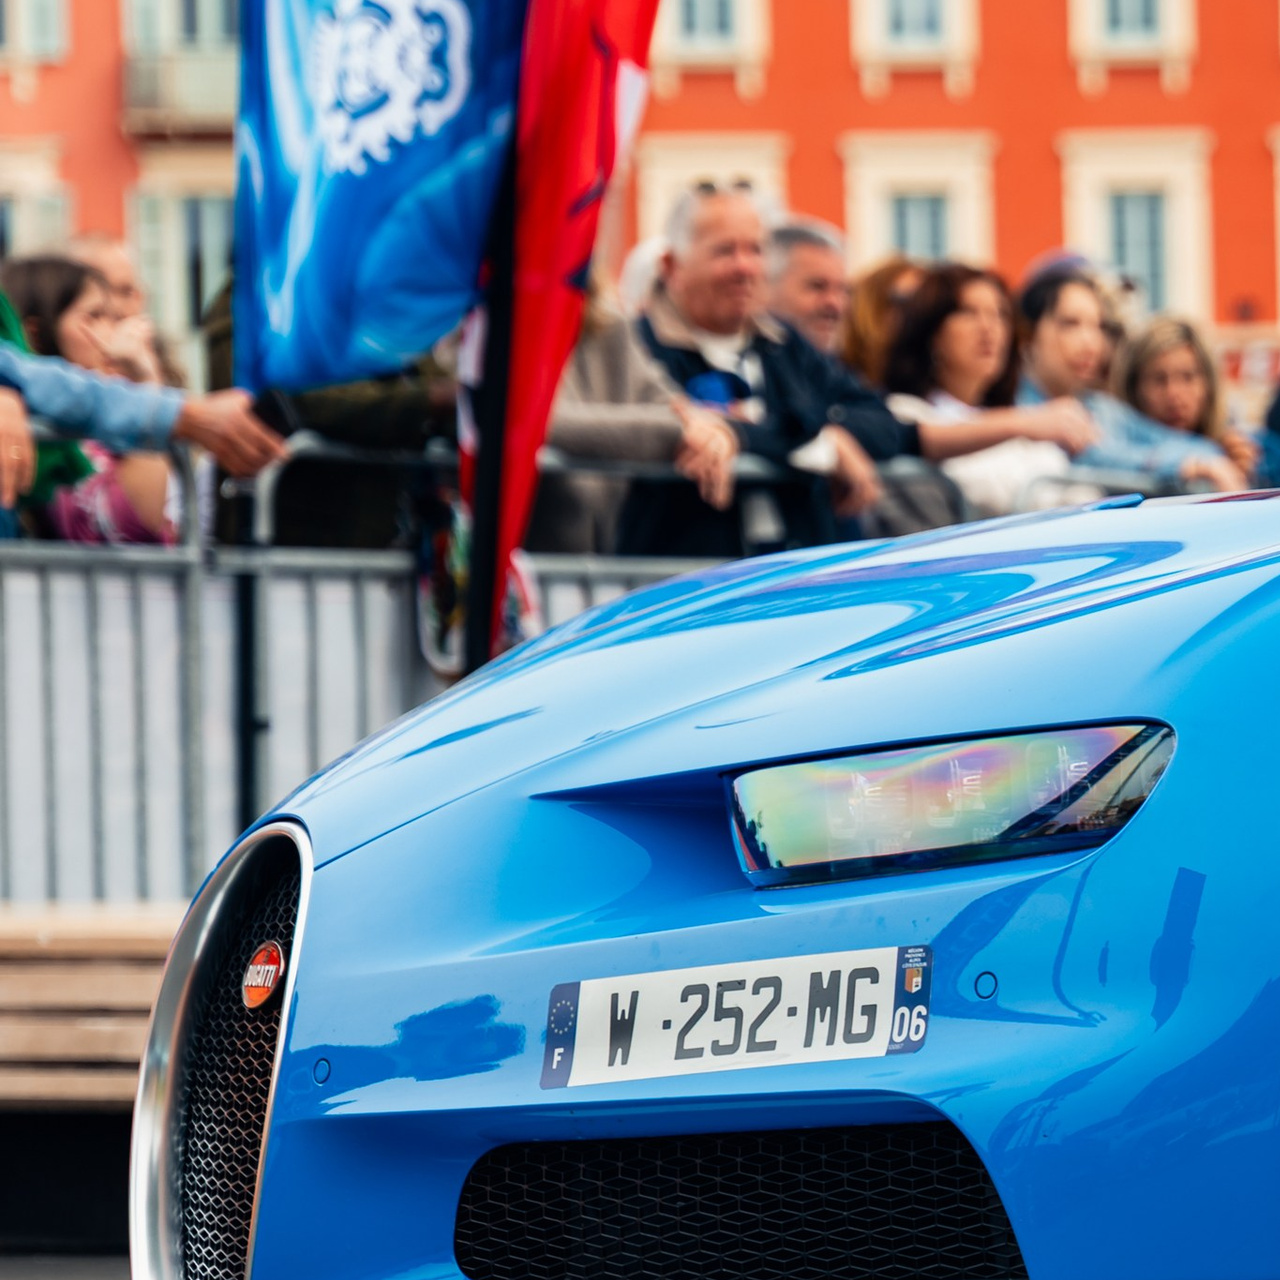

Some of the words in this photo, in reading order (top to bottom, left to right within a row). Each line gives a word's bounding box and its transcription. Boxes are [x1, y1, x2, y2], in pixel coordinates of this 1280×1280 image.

[608, 991, 639, 1067] W
[891, 1004, 926, 1044] 06
[552, 1047, 564, 1070] F
